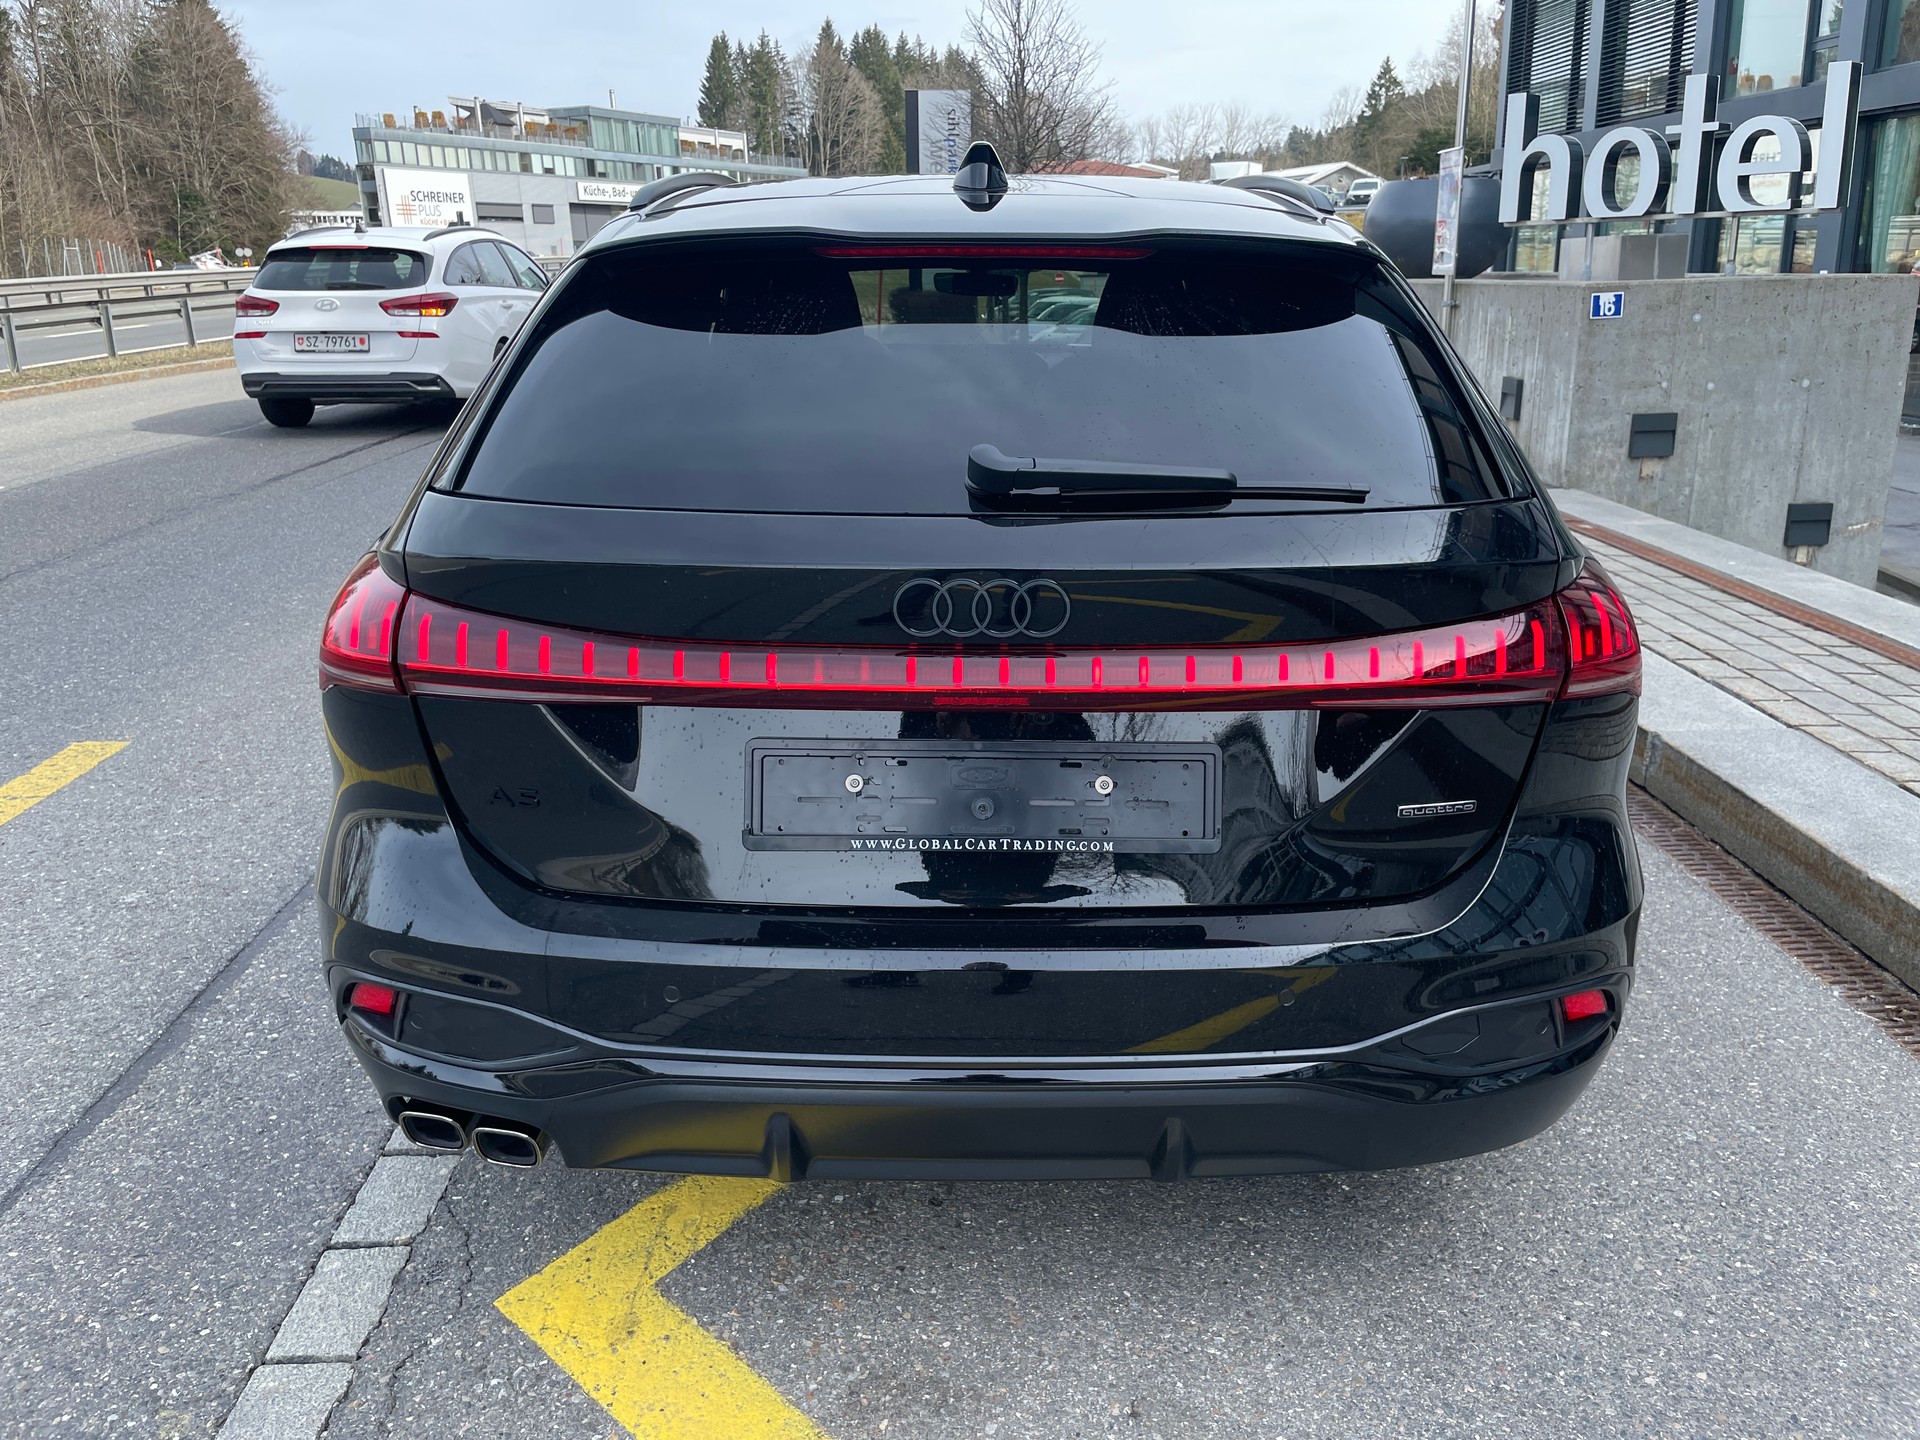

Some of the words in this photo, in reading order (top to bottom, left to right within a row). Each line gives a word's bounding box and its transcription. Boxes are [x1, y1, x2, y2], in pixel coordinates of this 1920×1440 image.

[1499, 61, 1861, 223] hotel
[410, 190, 465, 204] SCHREINER
[583, 185, 612, 199] Küche-,
[612, 186, 629, 198] Bad-
[418, 204, 442, 217] PLUS
[1402, 803, 1474, 817] quattro
